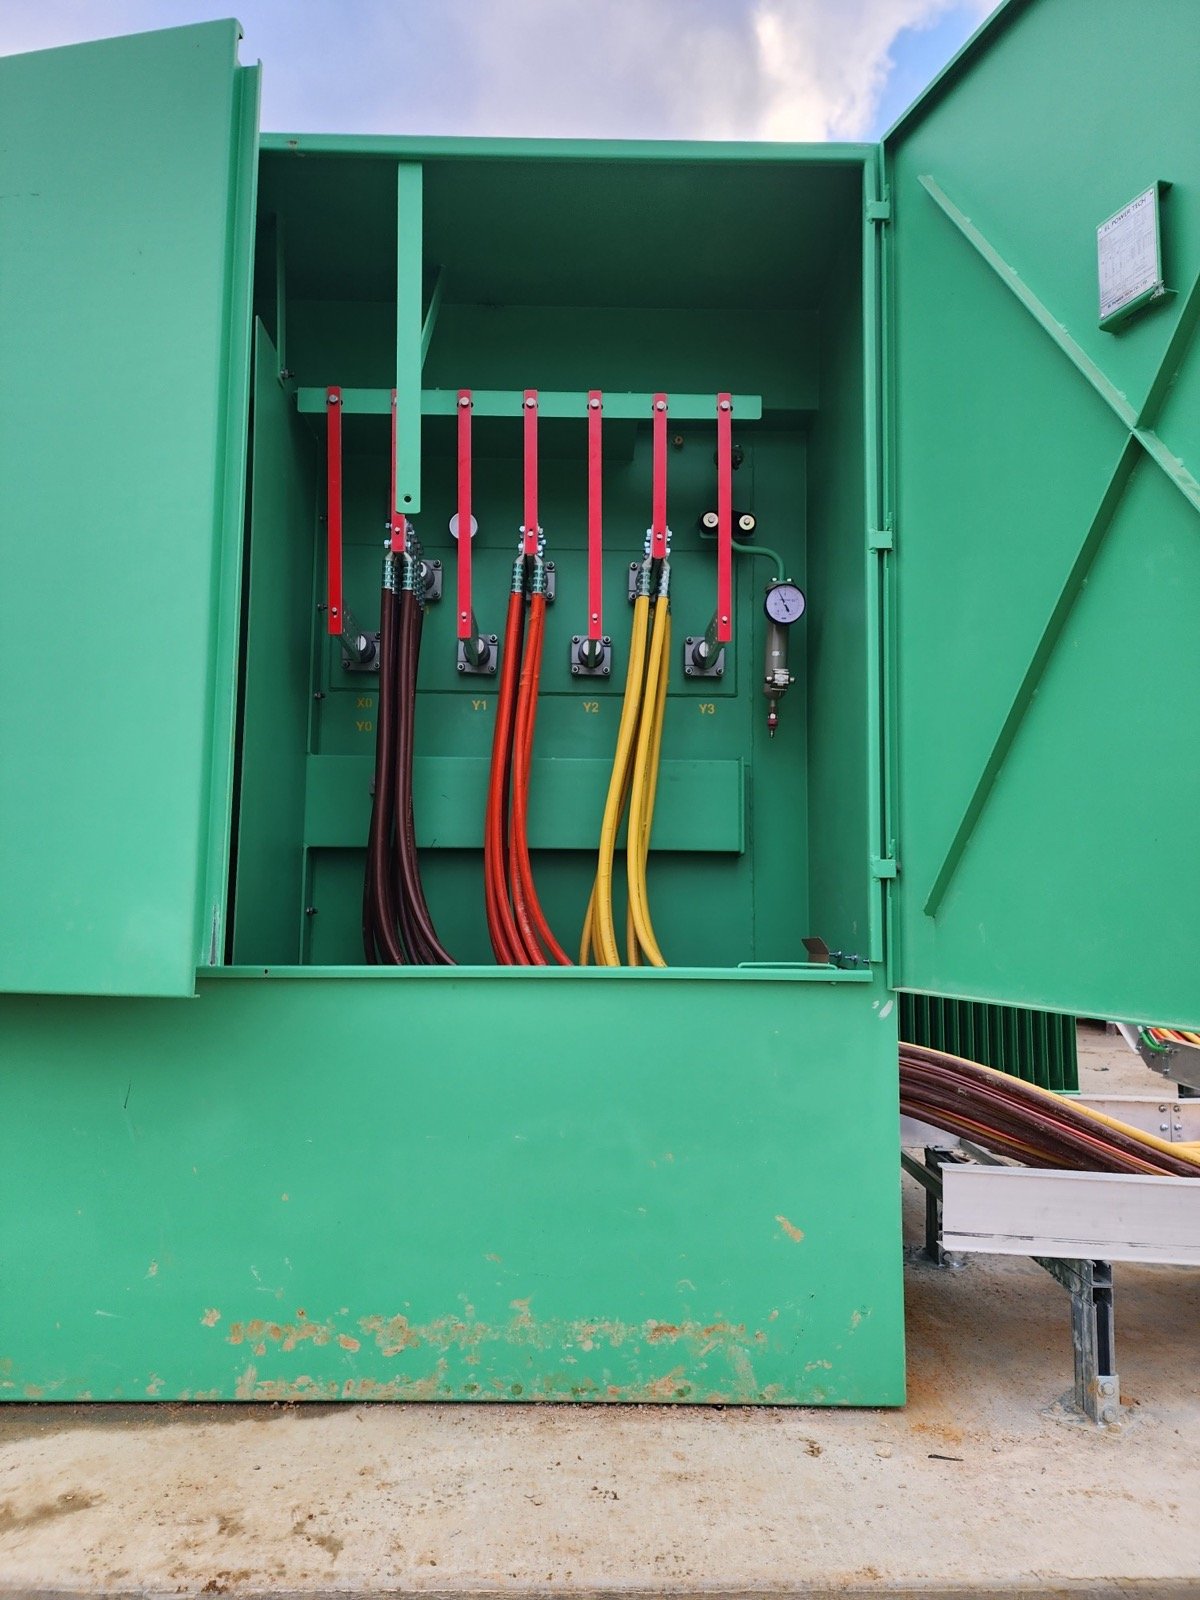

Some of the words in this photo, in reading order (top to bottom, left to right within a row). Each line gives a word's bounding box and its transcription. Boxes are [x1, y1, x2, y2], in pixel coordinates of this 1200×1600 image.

[1111, 209, 1131, 225] POWER
[1132, 197, 1147, 210] TECH
[356, 697, 373, 708] X0
[472, 700, 487, 711] Y1
[583, 702, 599, 713] Y2
[699, 703, 715, 714] Y3
[356, 721, 372, 732] Y0
